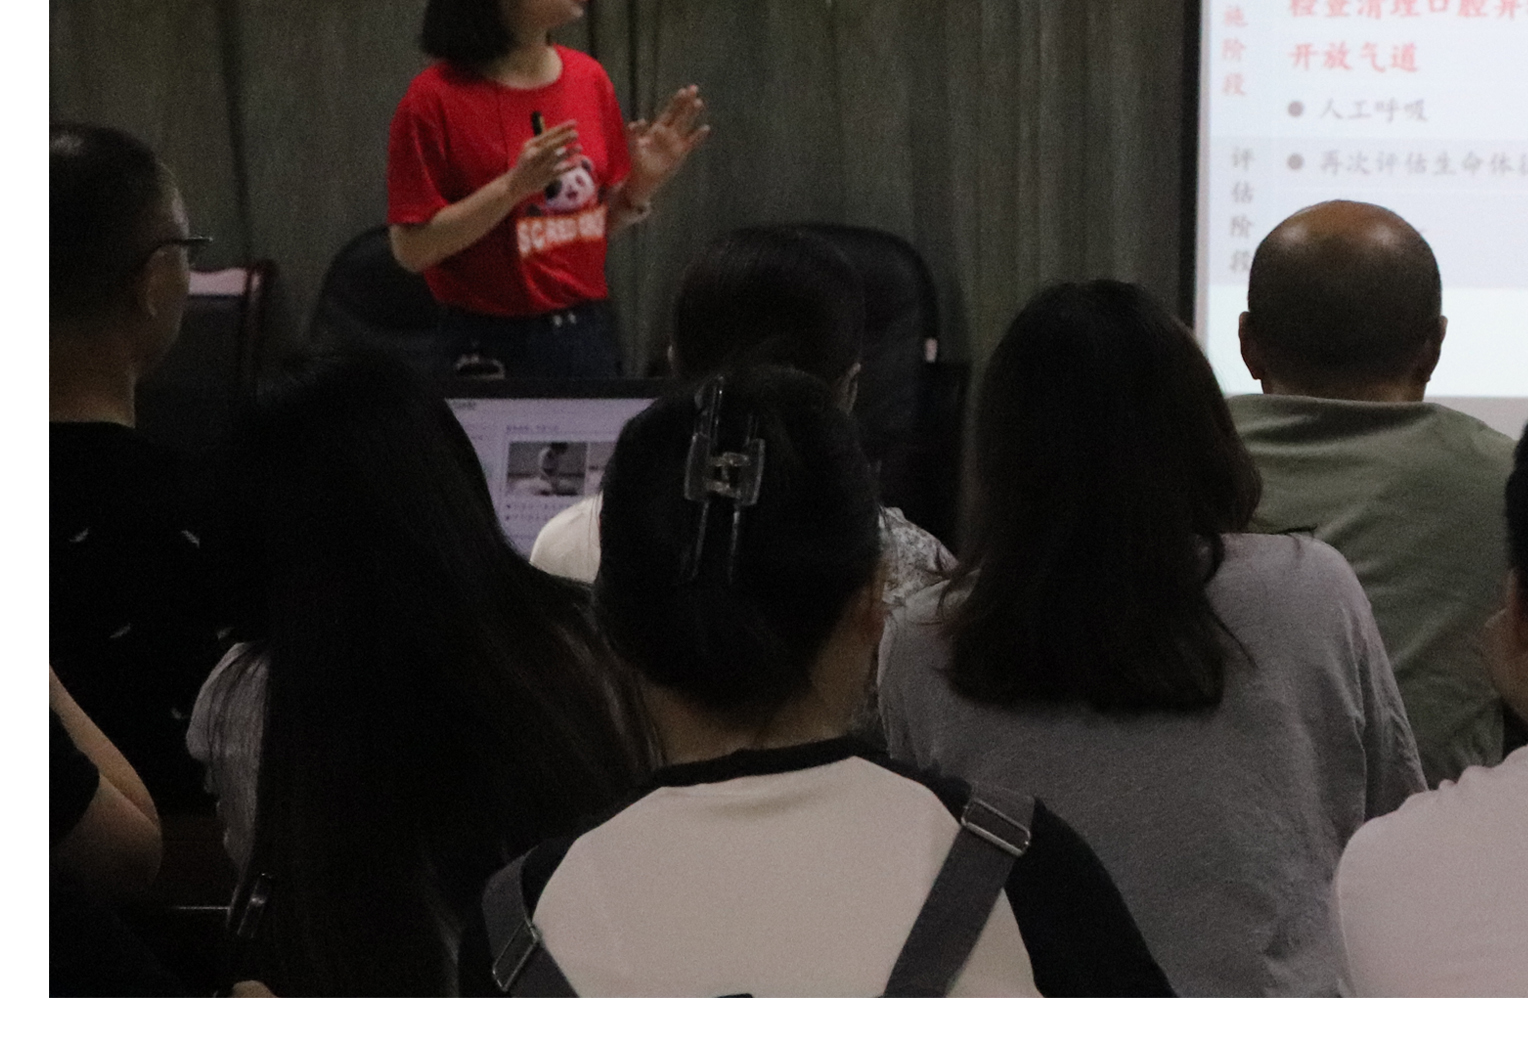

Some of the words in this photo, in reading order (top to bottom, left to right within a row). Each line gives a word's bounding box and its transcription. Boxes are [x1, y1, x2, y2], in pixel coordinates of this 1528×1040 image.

[1290, 41, 1420, 75] 开放气道
[1320, 97, 1429, 124] 人工呼吸
